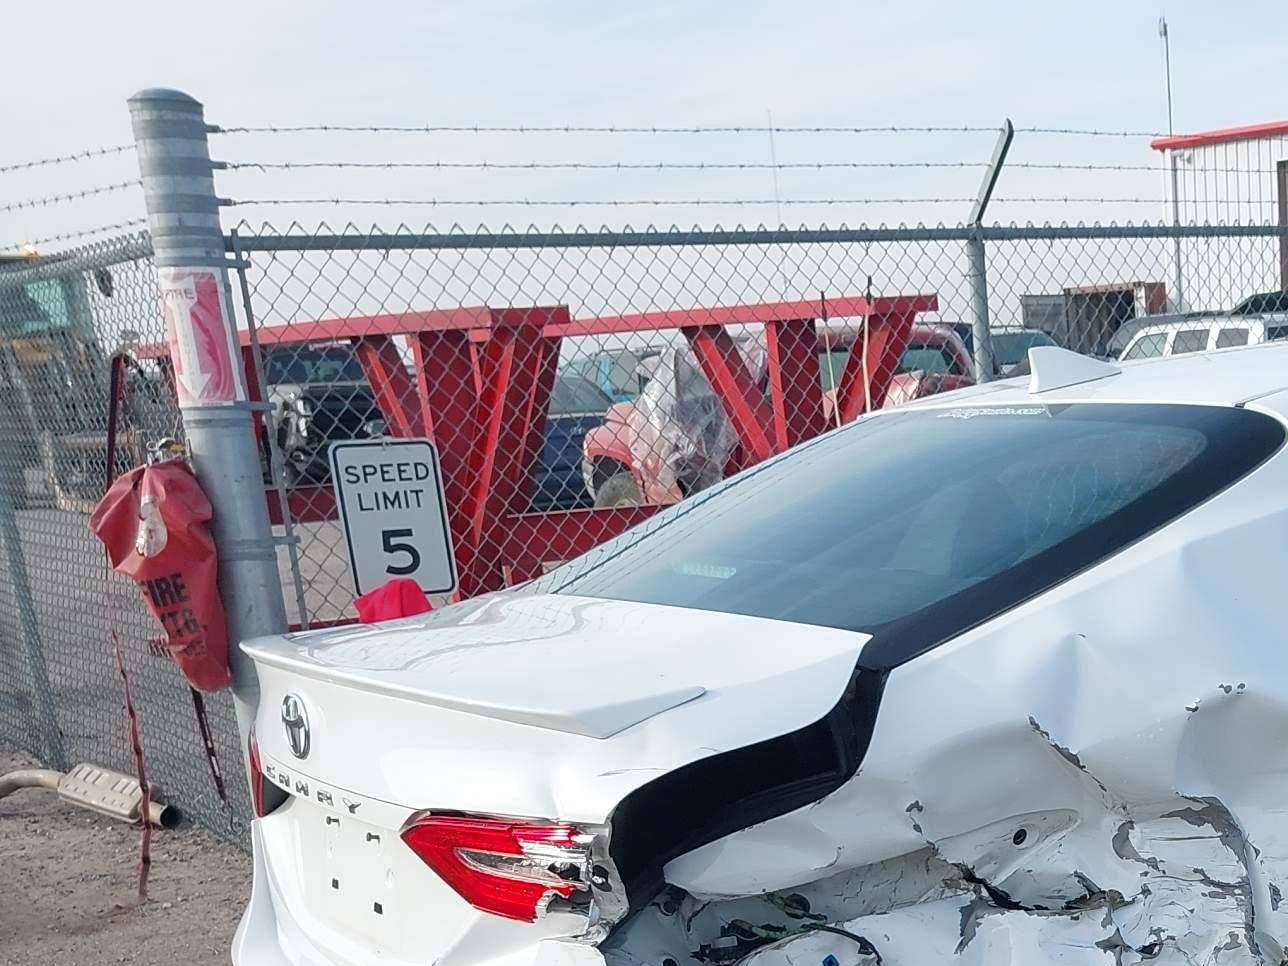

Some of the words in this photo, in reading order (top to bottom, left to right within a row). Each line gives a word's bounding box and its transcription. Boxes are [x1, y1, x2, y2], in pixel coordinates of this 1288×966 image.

[344, 462, 430, 485] SPEED
[357, 489, 424, 512] LIMIT
[381, 528, 421, 576] 5
